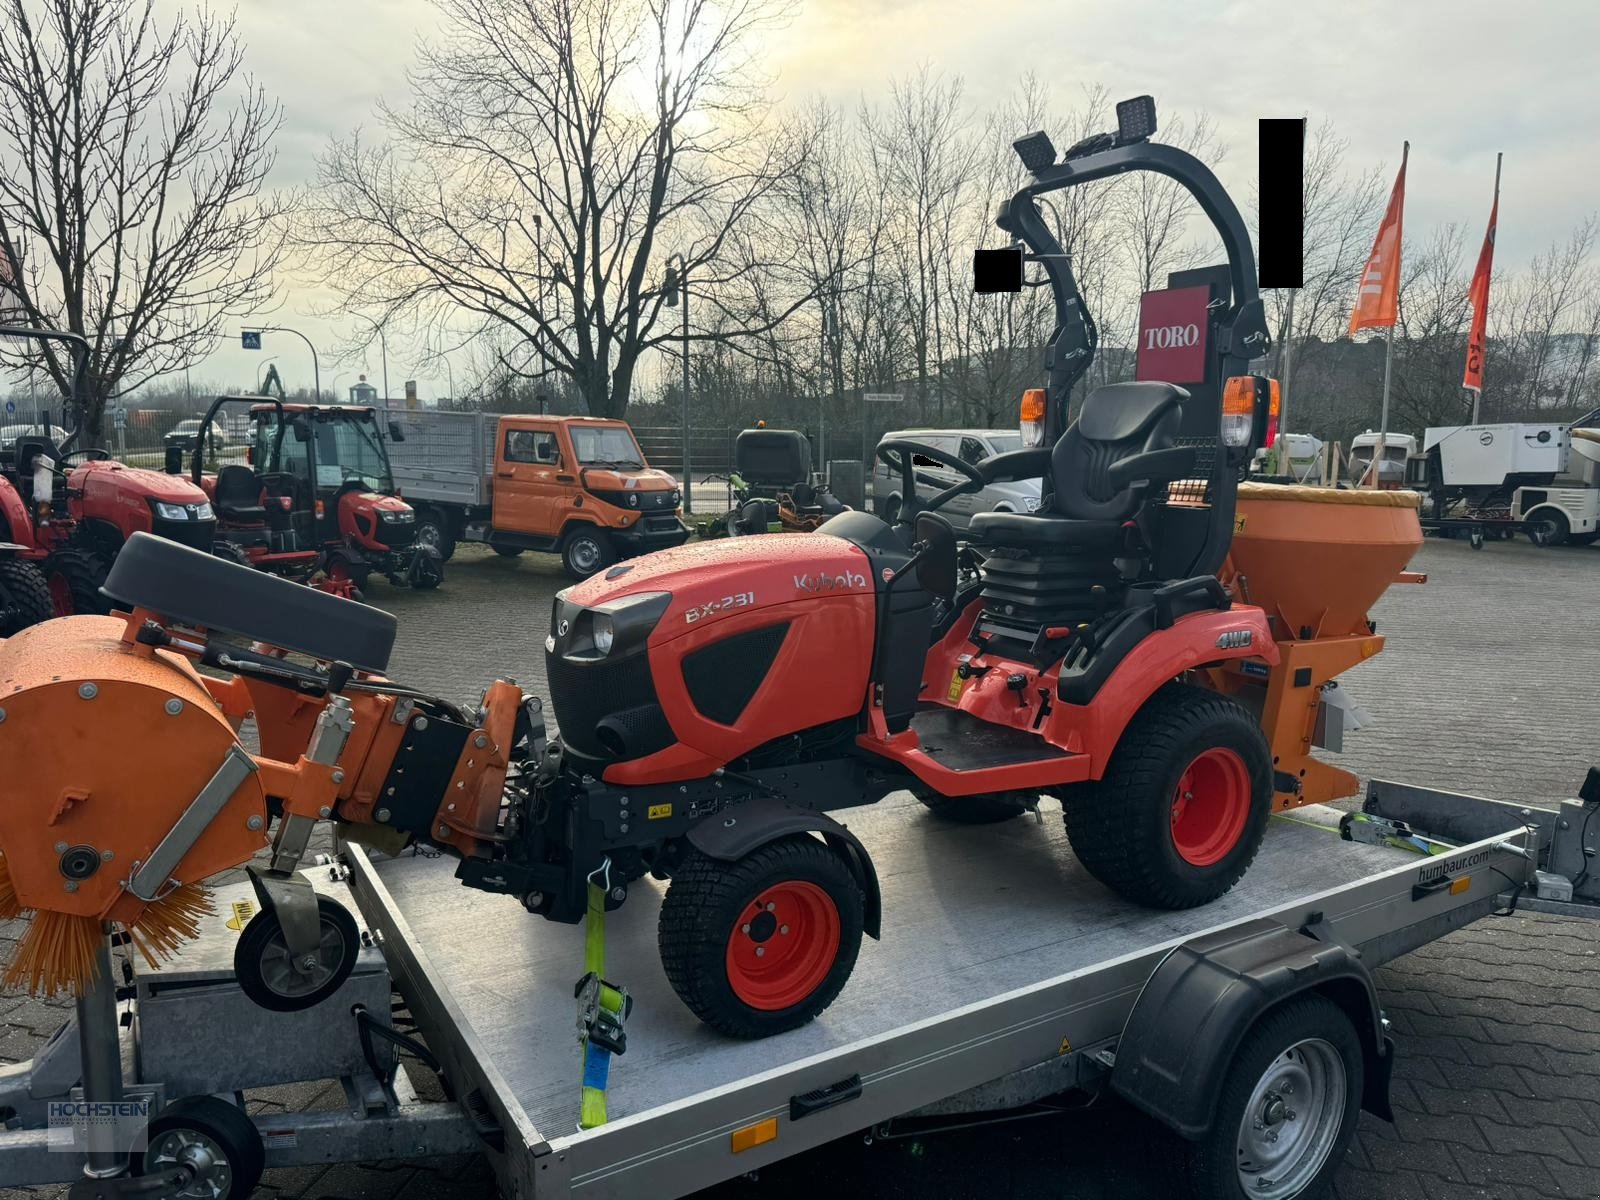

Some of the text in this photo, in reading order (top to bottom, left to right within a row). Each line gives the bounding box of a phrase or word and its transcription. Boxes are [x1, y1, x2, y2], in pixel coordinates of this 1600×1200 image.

[1145, 323, 1199, 350] TORO
[793, 569, 867, 592] Kubota
[684, 591, 755, 624] BX-231
[1215, 629, 1251, 649] 4WD
[1418, 850, 1489, 882] humbaur.com
